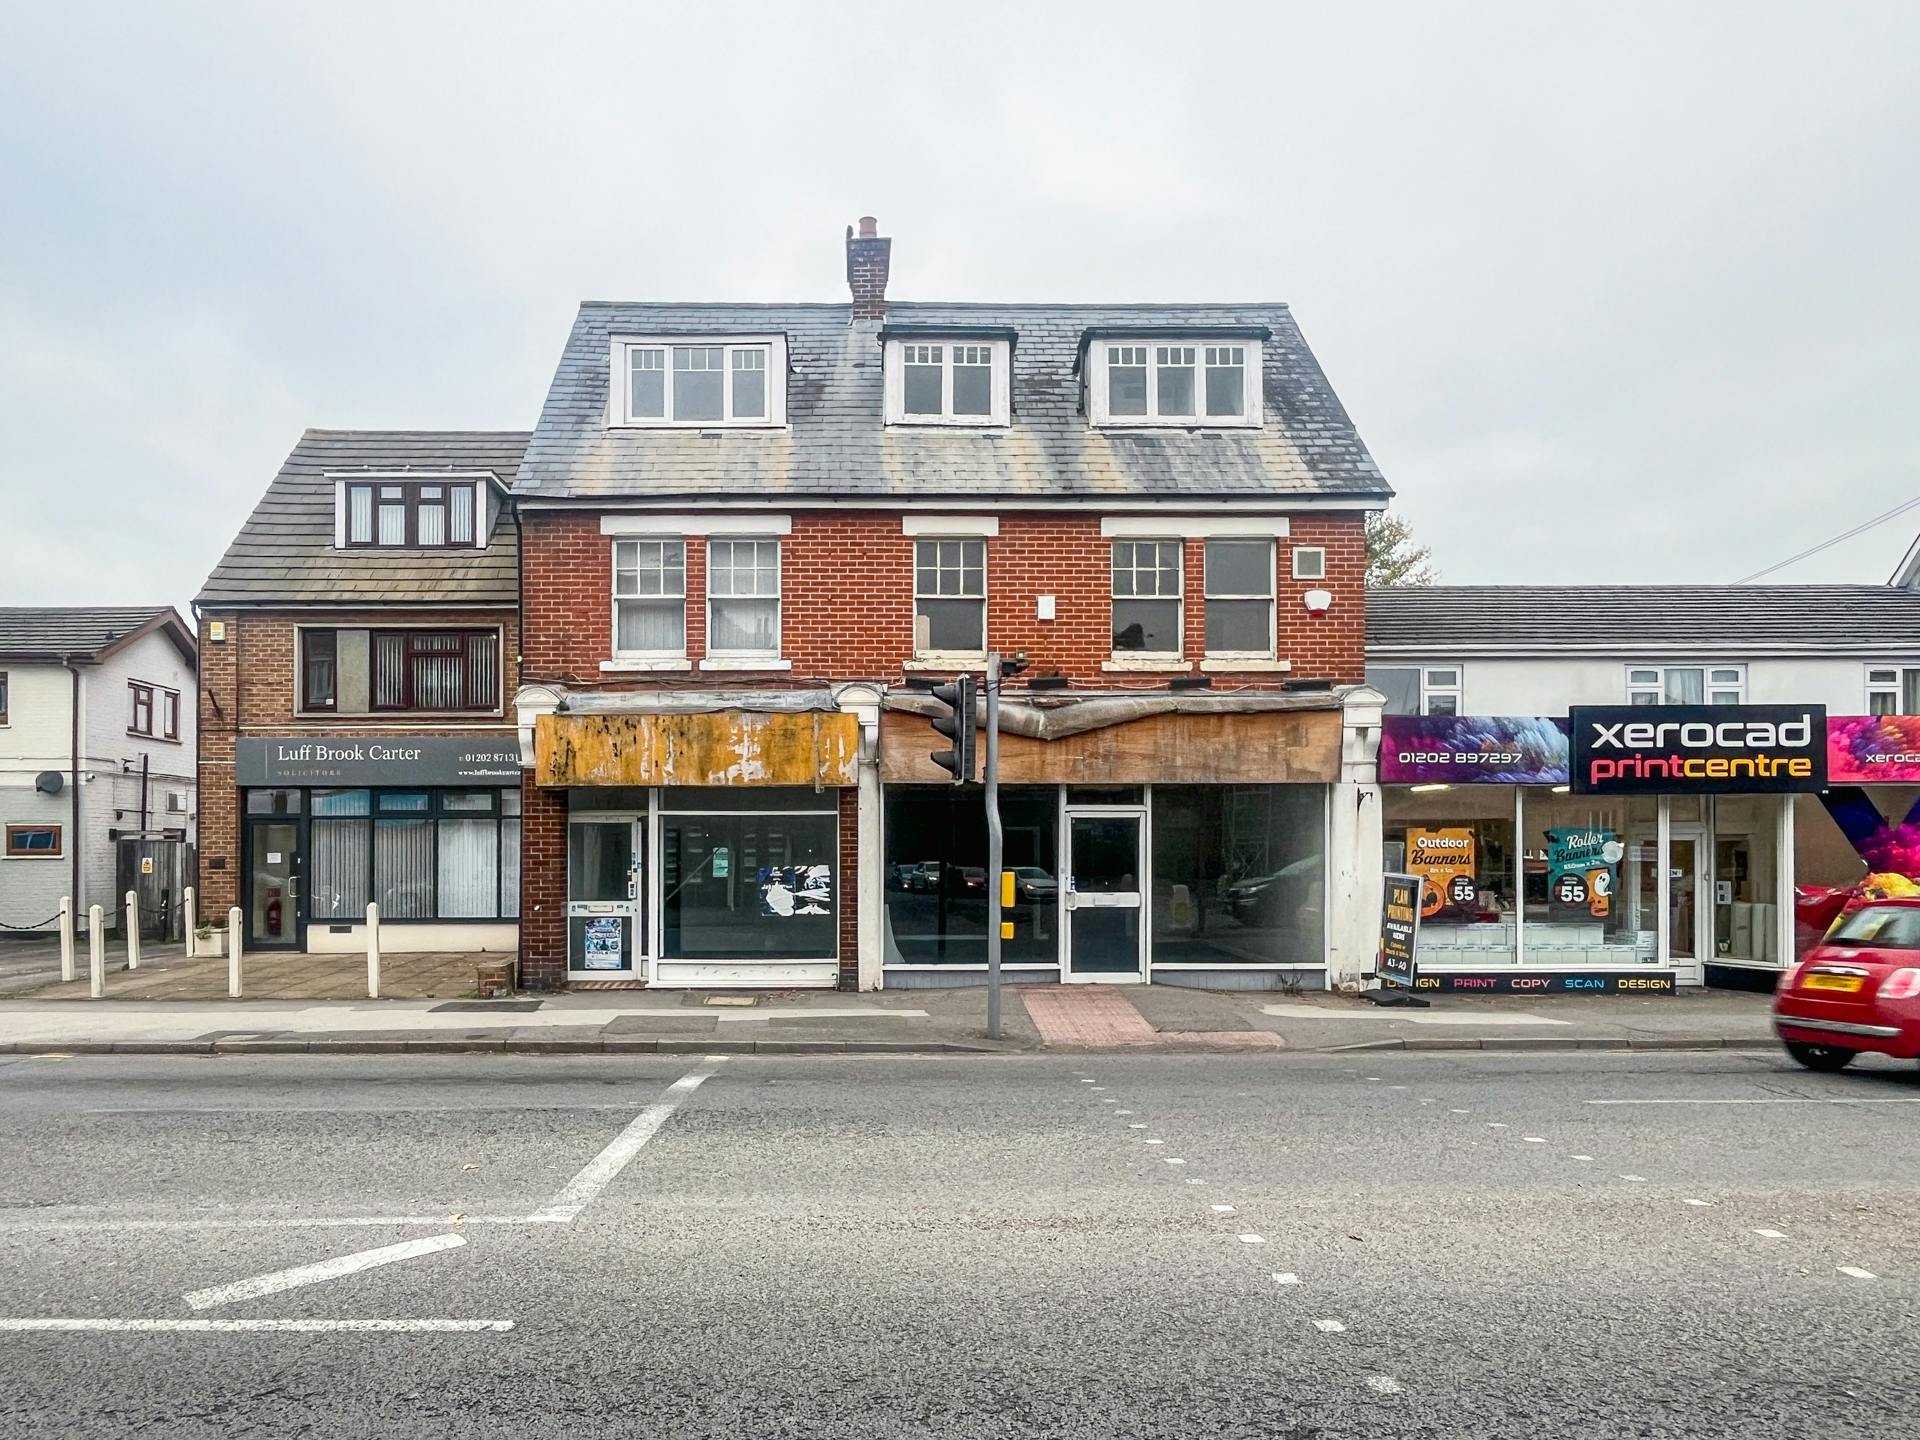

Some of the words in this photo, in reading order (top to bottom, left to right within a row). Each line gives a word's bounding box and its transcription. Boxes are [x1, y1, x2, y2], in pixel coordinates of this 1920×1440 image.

[1591, 714, 1811, 749] xerocad
[278, 745, 312, 761] Luff
[316, 744, 364, 761] Brook
[369, 745, 421, 761] Carter
[465, 753, 491, 762] 01202
[1399, 752, 1450, 763] 01202
[1455, 752, 1522, 763] 897297
[1591, 753, 1812, 784] printcentre
[1417, 837, 1470, 848] Outdoor
[1566, 832, 1604, 850] Roller
[1411, 849, 1471, 865] Banners
[1554, 846, 1604, 863] Banners
[1393, 888, 1408, 905] PLAN
[1387, 904, 1413, 922] PRINTING
[1387, 922, 1412, 933] AVAILABLE
[1386, 978, 1440, 988] DIGN
[1454, 979, 1497, 988] PRINT
[1511, 979, 1550, 988] COPY
[1565, 979, 1605, 988] SCAN
[1618, 979, 1671, 989] DESIGN
